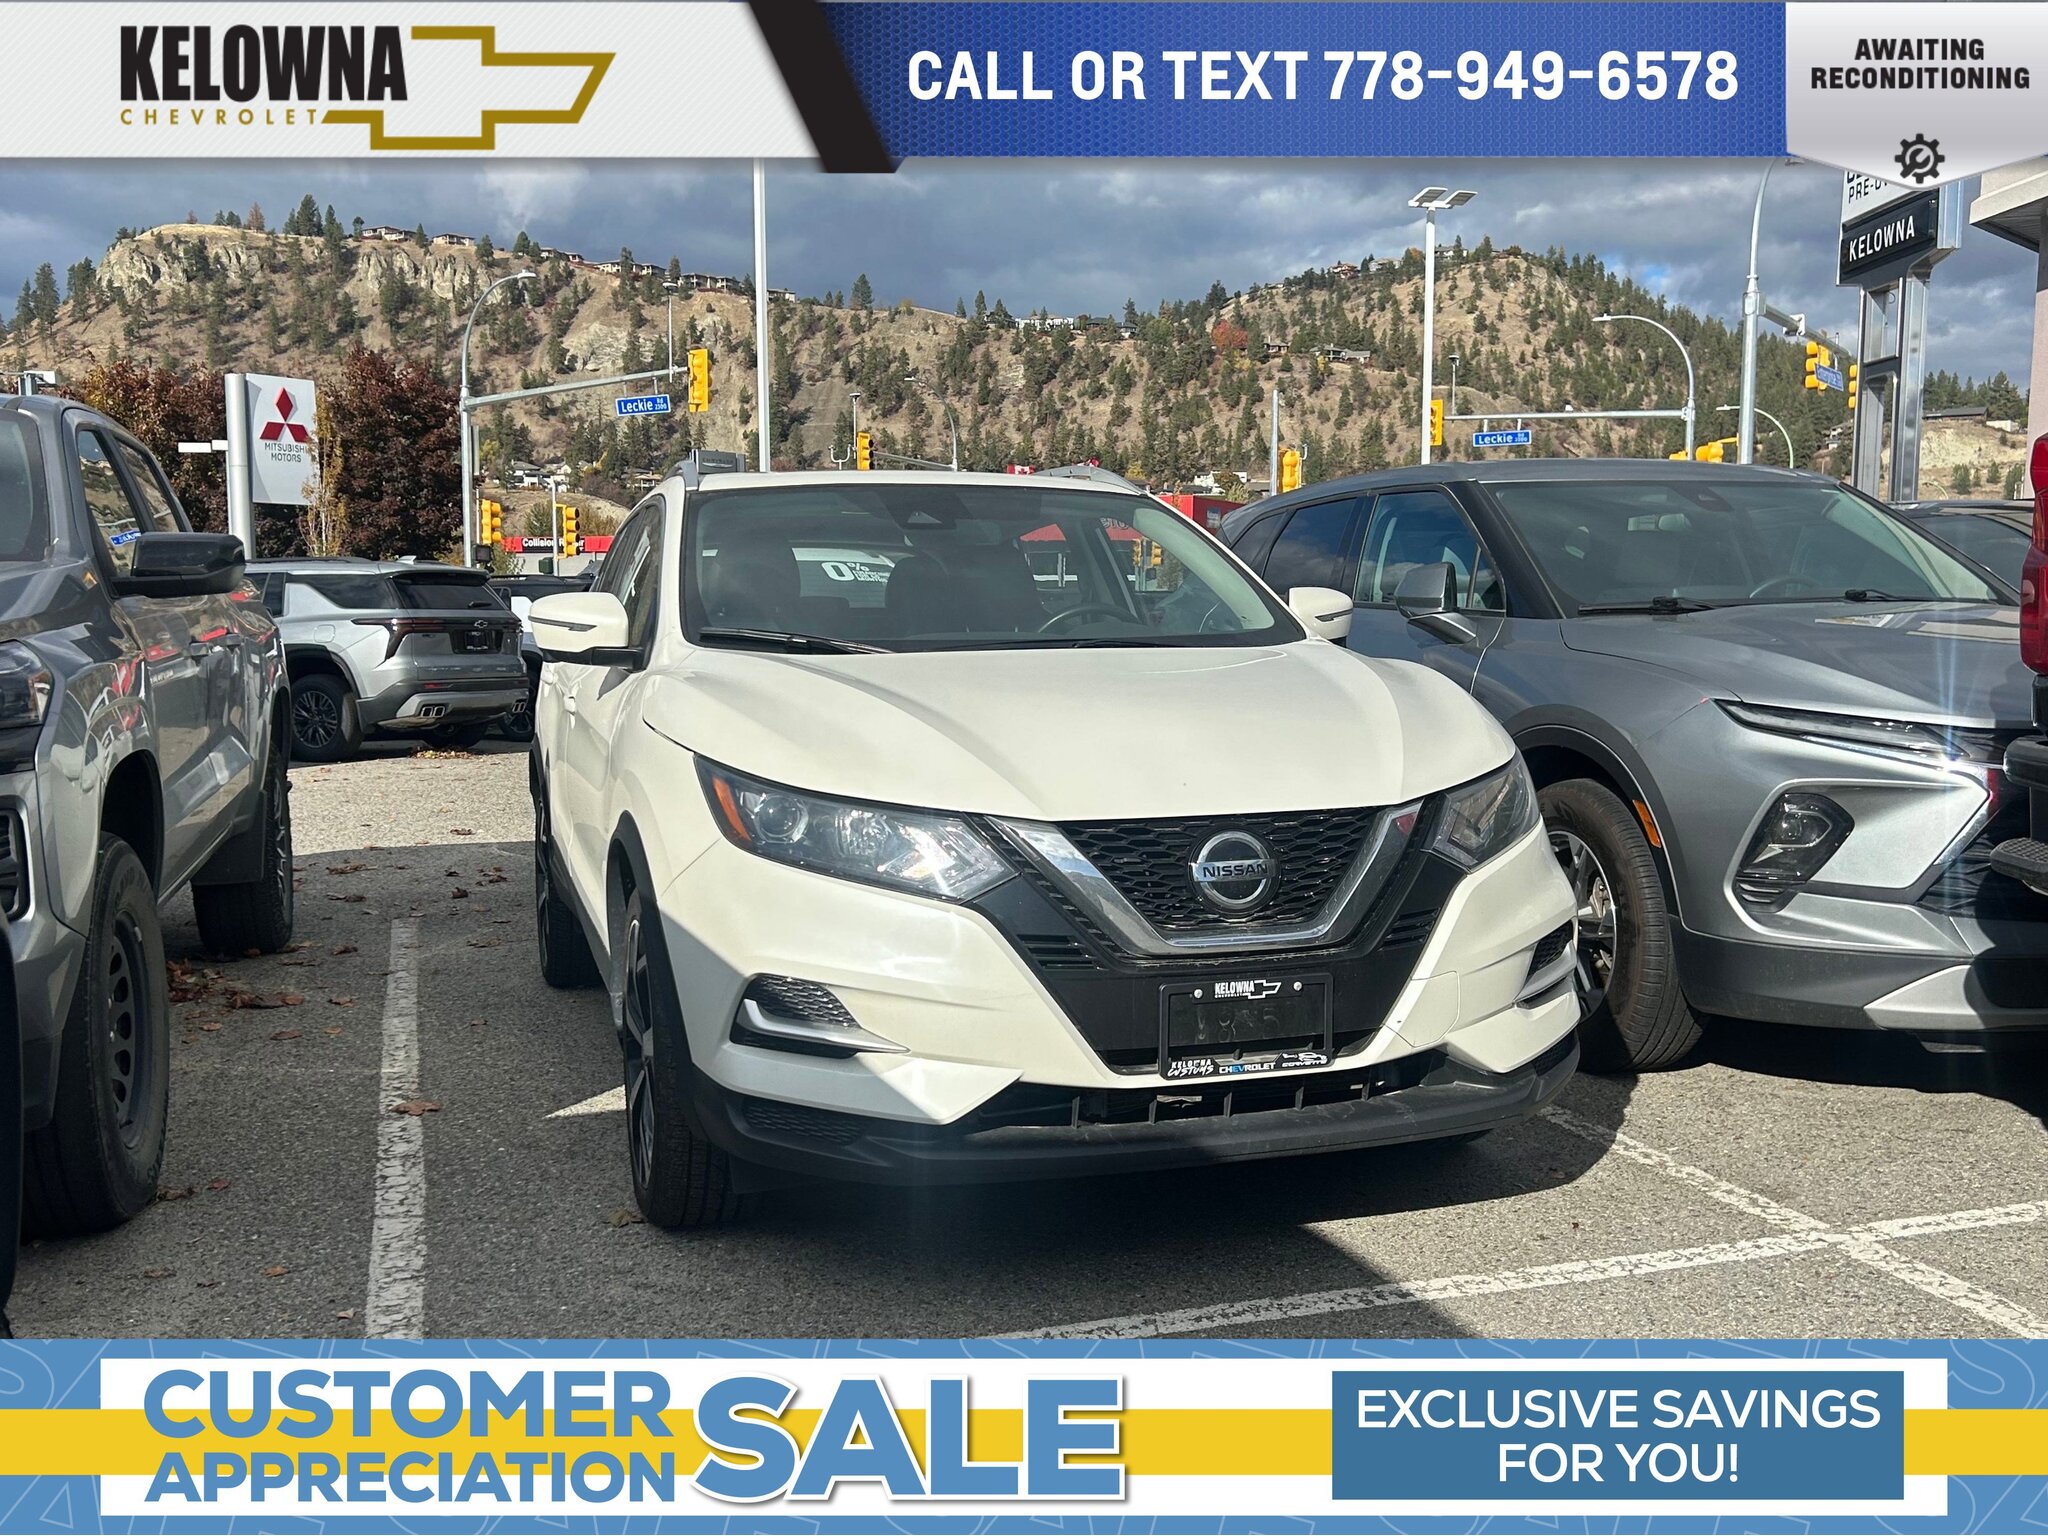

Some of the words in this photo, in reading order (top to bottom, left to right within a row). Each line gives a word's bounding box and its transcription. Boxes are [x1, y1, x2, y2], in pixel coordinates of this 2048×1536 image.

[1849, 215, 1916, 262] KELOWNA
[621, 399, 653, 413] Leckie
[1478, 433, 1513, 445] Leckie
[271, 452, 302, 463] MOTORS
[1203, 862, 1268, 878] NISSAN
[1214, 980, 1255, 994] KELOWNA
[1219, 1063, 1276, 1074] CHEVROLET
